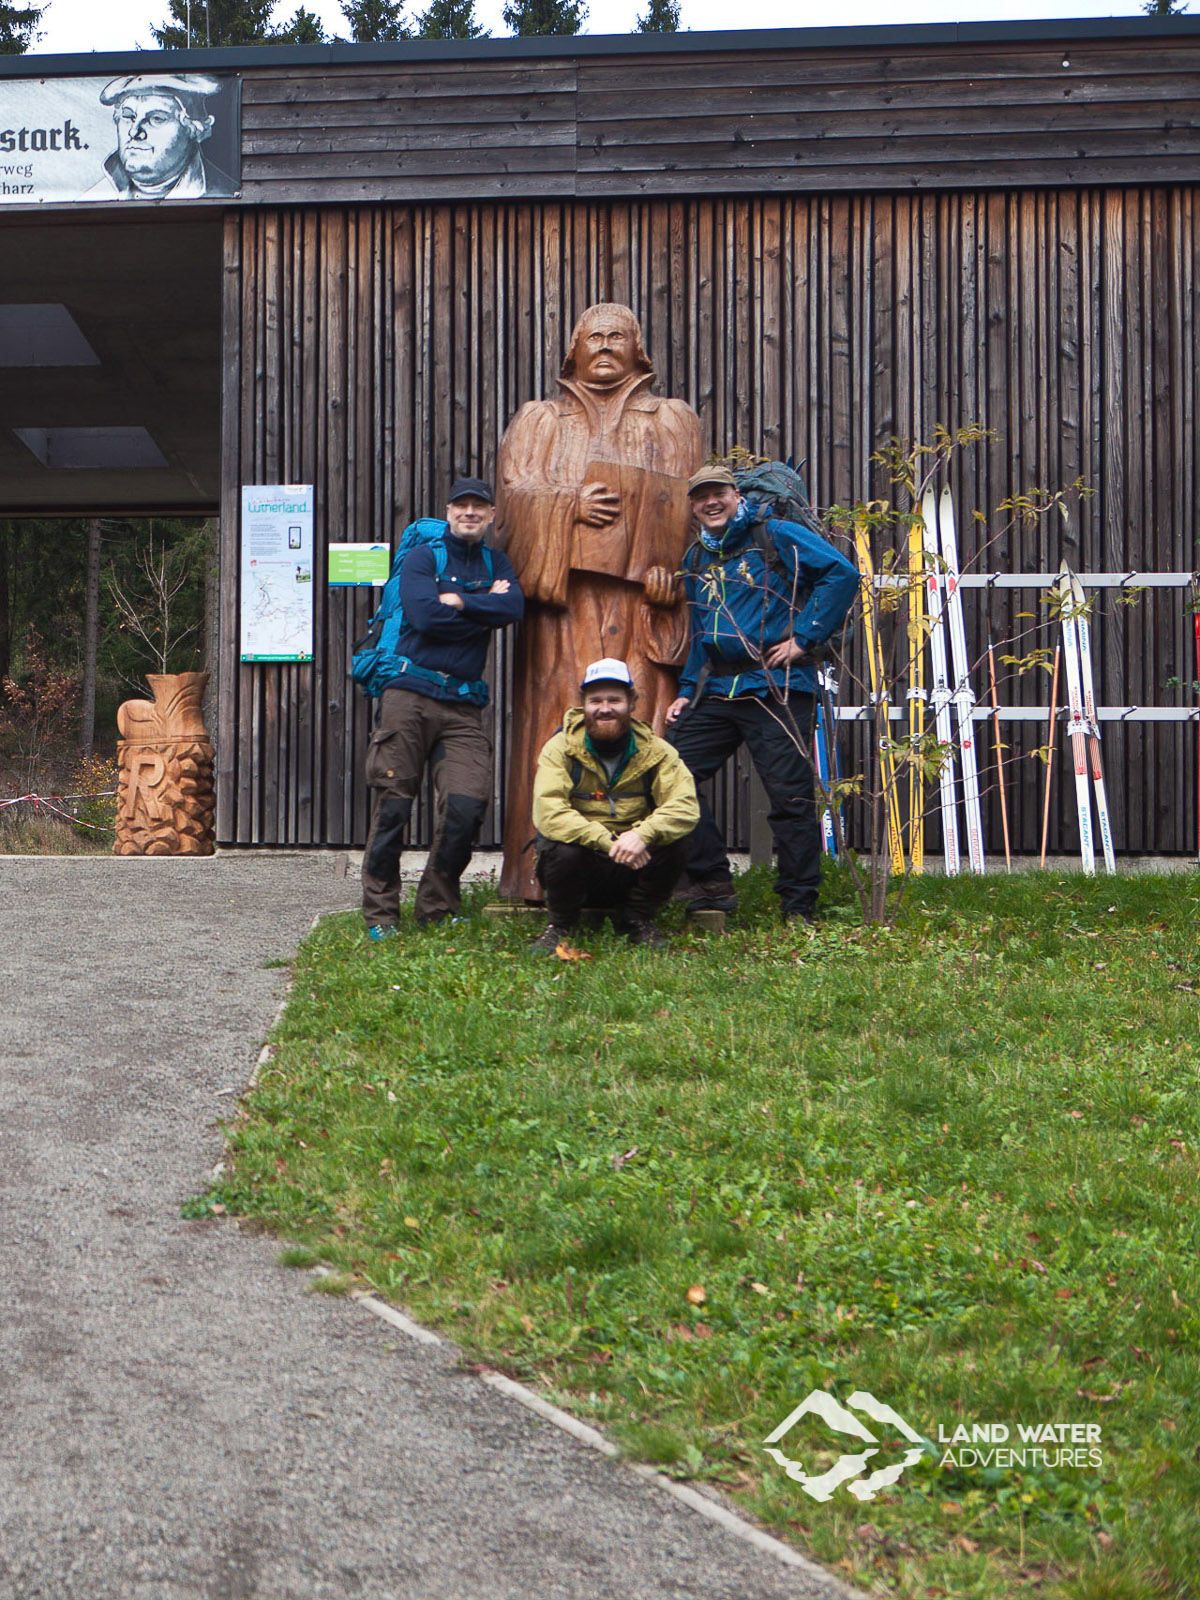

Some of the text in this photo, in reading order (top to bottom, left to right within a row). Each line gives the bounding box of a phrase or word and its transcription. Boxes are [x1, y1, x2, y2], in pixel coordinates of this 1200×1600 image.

[0, 119, 89, 152] stark.
[248, 500, 306, 513] Lutherland
[126, 754, 165, 821] R
[1081, 806, 1089, 848] STACANT
[1101, 811, 1111, 852] STACANT
